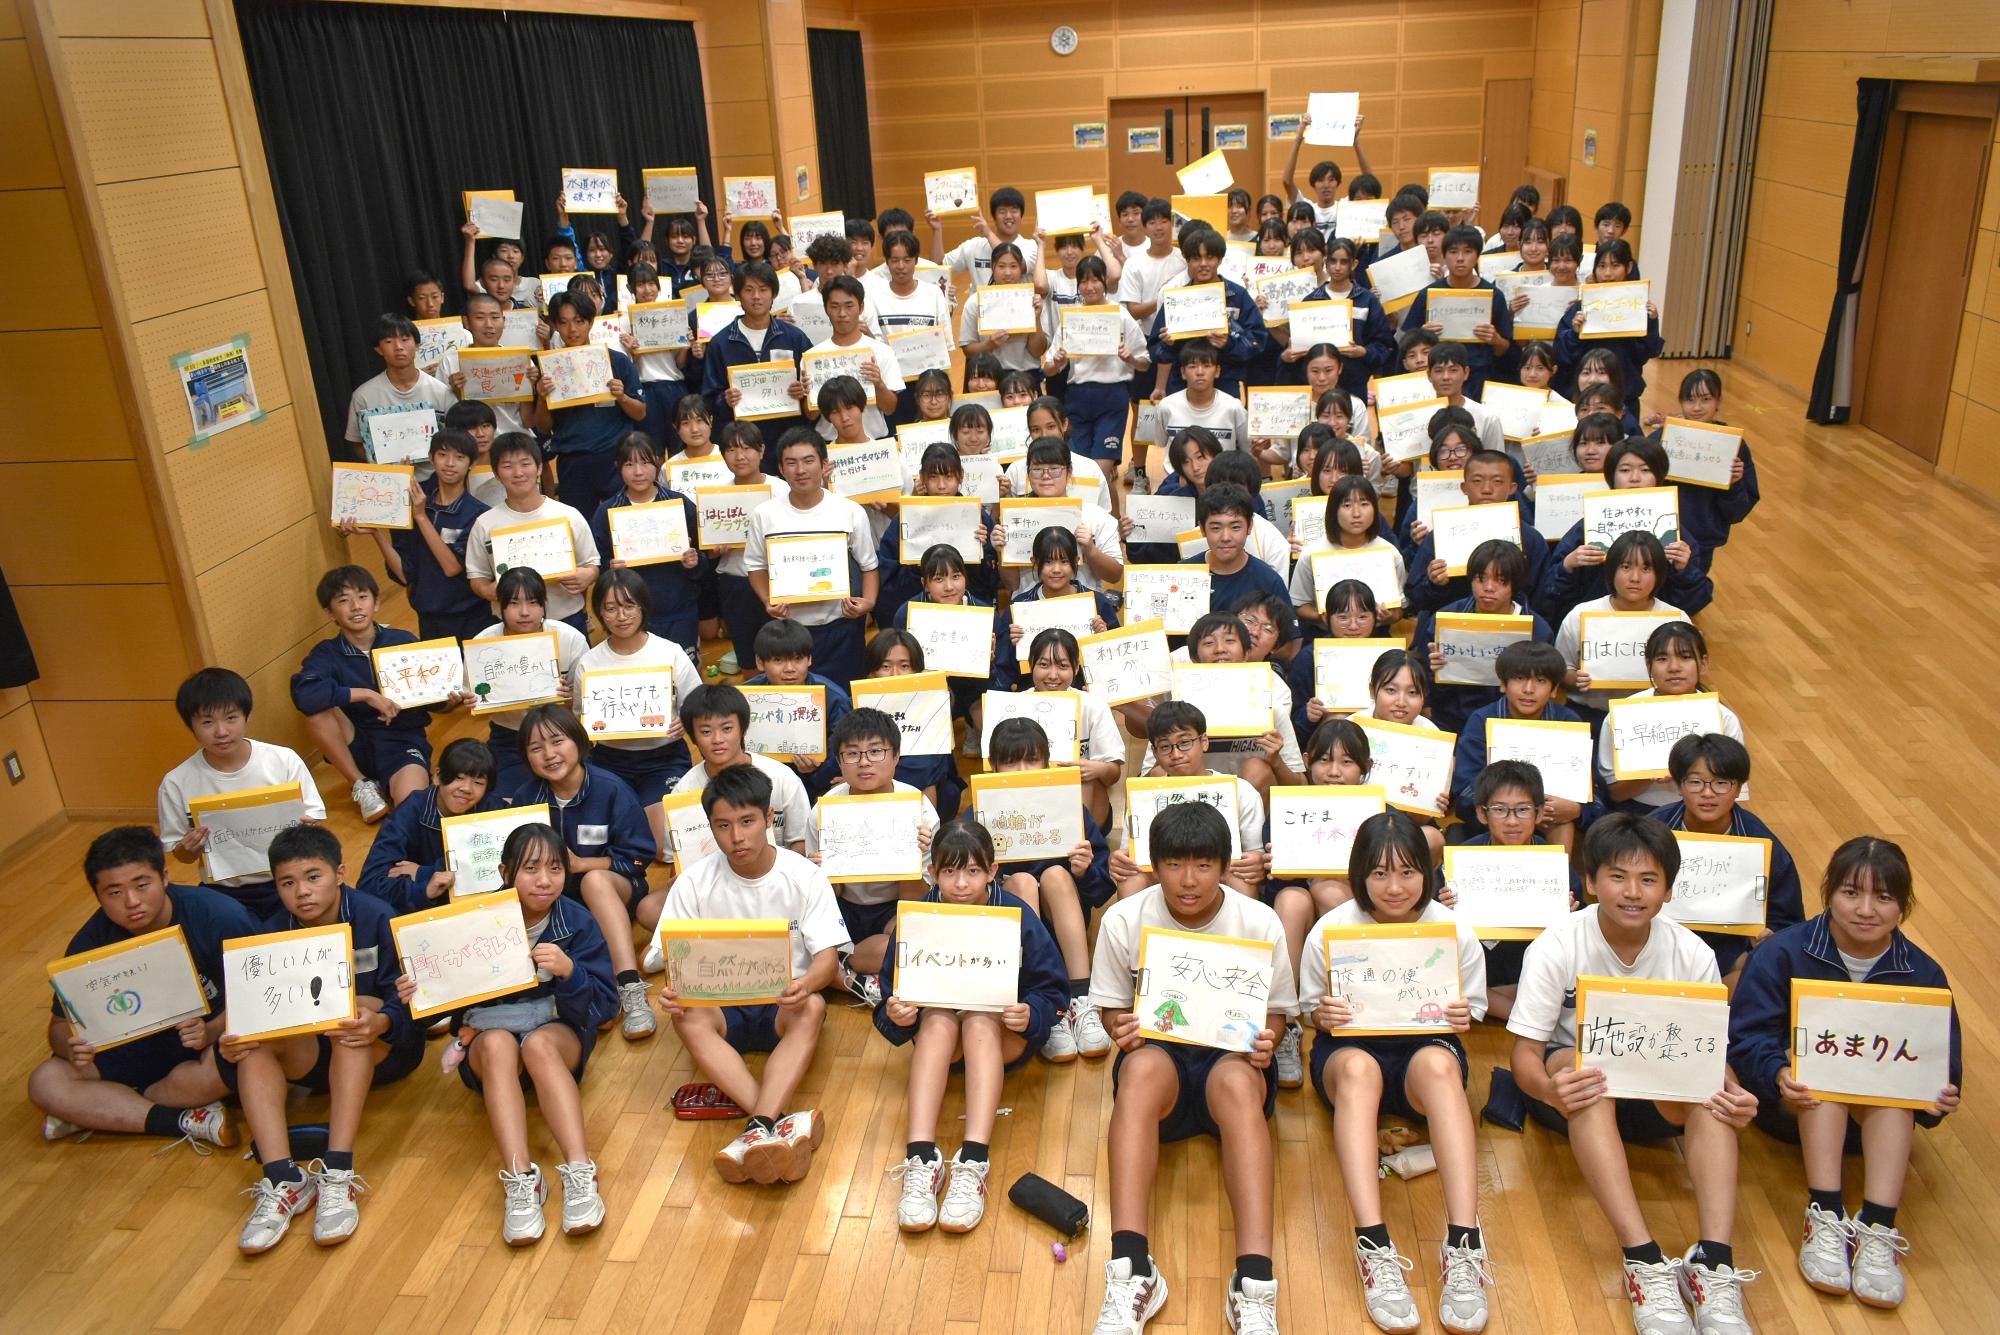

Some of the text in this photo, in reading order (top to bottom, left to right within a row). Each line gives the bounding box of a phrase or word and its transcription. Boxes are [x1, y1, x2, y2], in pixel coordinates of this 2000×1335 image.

[567, 177, 610, 191] 水道水が
[1602, 507, 1653, 520] 住みやすくて
[1096, 640, 1150, 661] 利便性
[397, 663, 441, 690] 平和
[484, 657, 546, 682] 自然が豊か
[592, 686, 661, 700] どこにでも
[1284, 810, 1333, 825] こだま
[242, 946, 332, 979] 優しい人が
[414, 925, 522, 979] 町がキレイ
[910, 948, 1007, 967] イベントが多い
[1170, 952, 1269, 1001] 安心安全
[1341, 964, 1421, 984] 交通の便
[1397, 984, 1449, 1002] がいい
[1587, 1014, 1716, 1062] 施設が整ってる
[1814, 1031, 1919, 1062] あまりん
